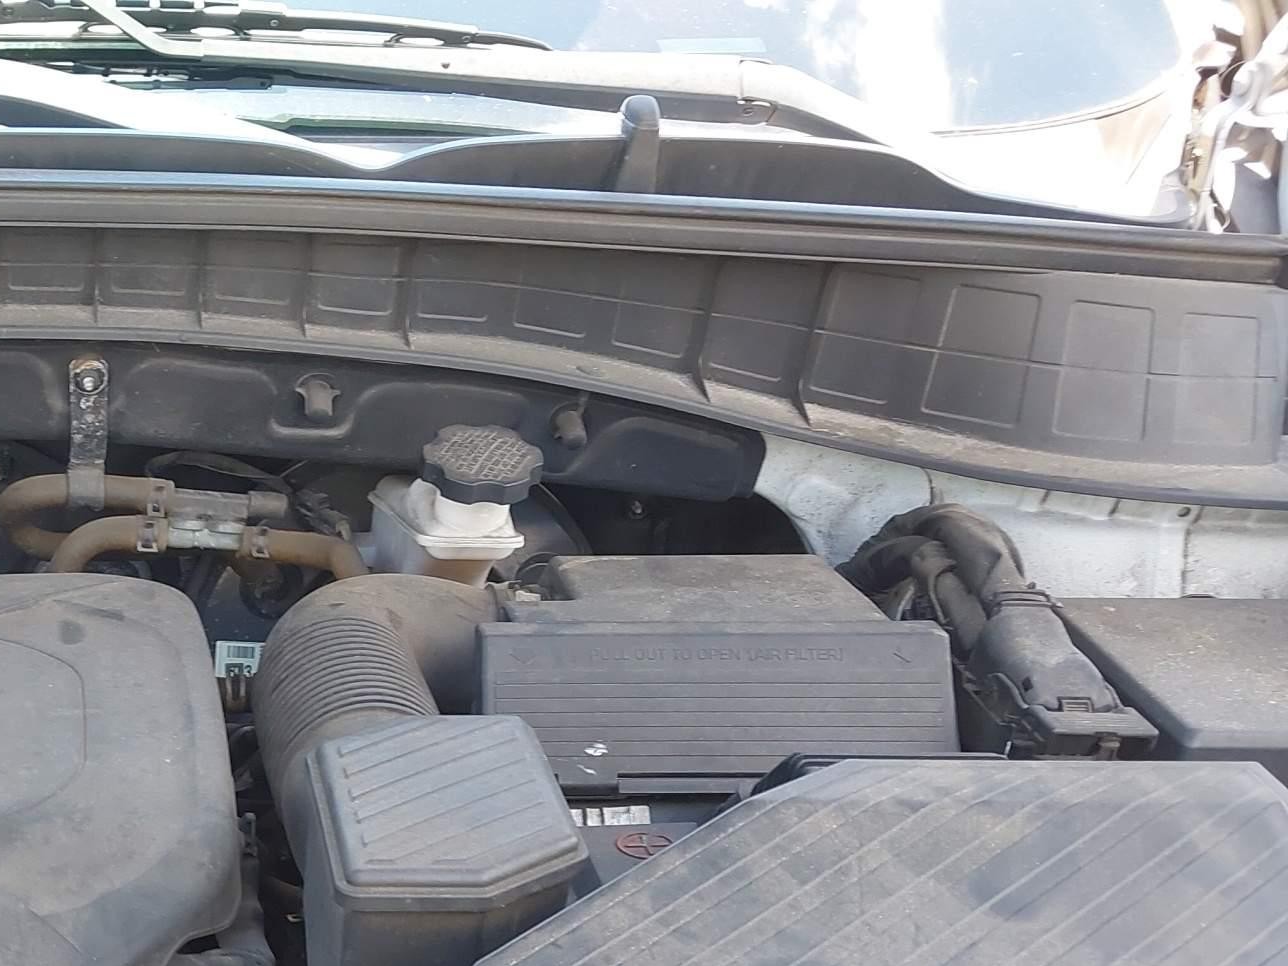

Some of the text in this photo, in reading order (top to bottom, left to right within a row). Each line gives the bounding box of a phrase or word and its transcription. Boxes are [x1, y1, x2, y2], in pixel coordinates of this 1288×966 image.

[590, 647, 630, 661] PULL
[633, 647, 666, 661] OUT
[671, 647, 692, 661] TO
[696, 647, 742, 661] OPEN
